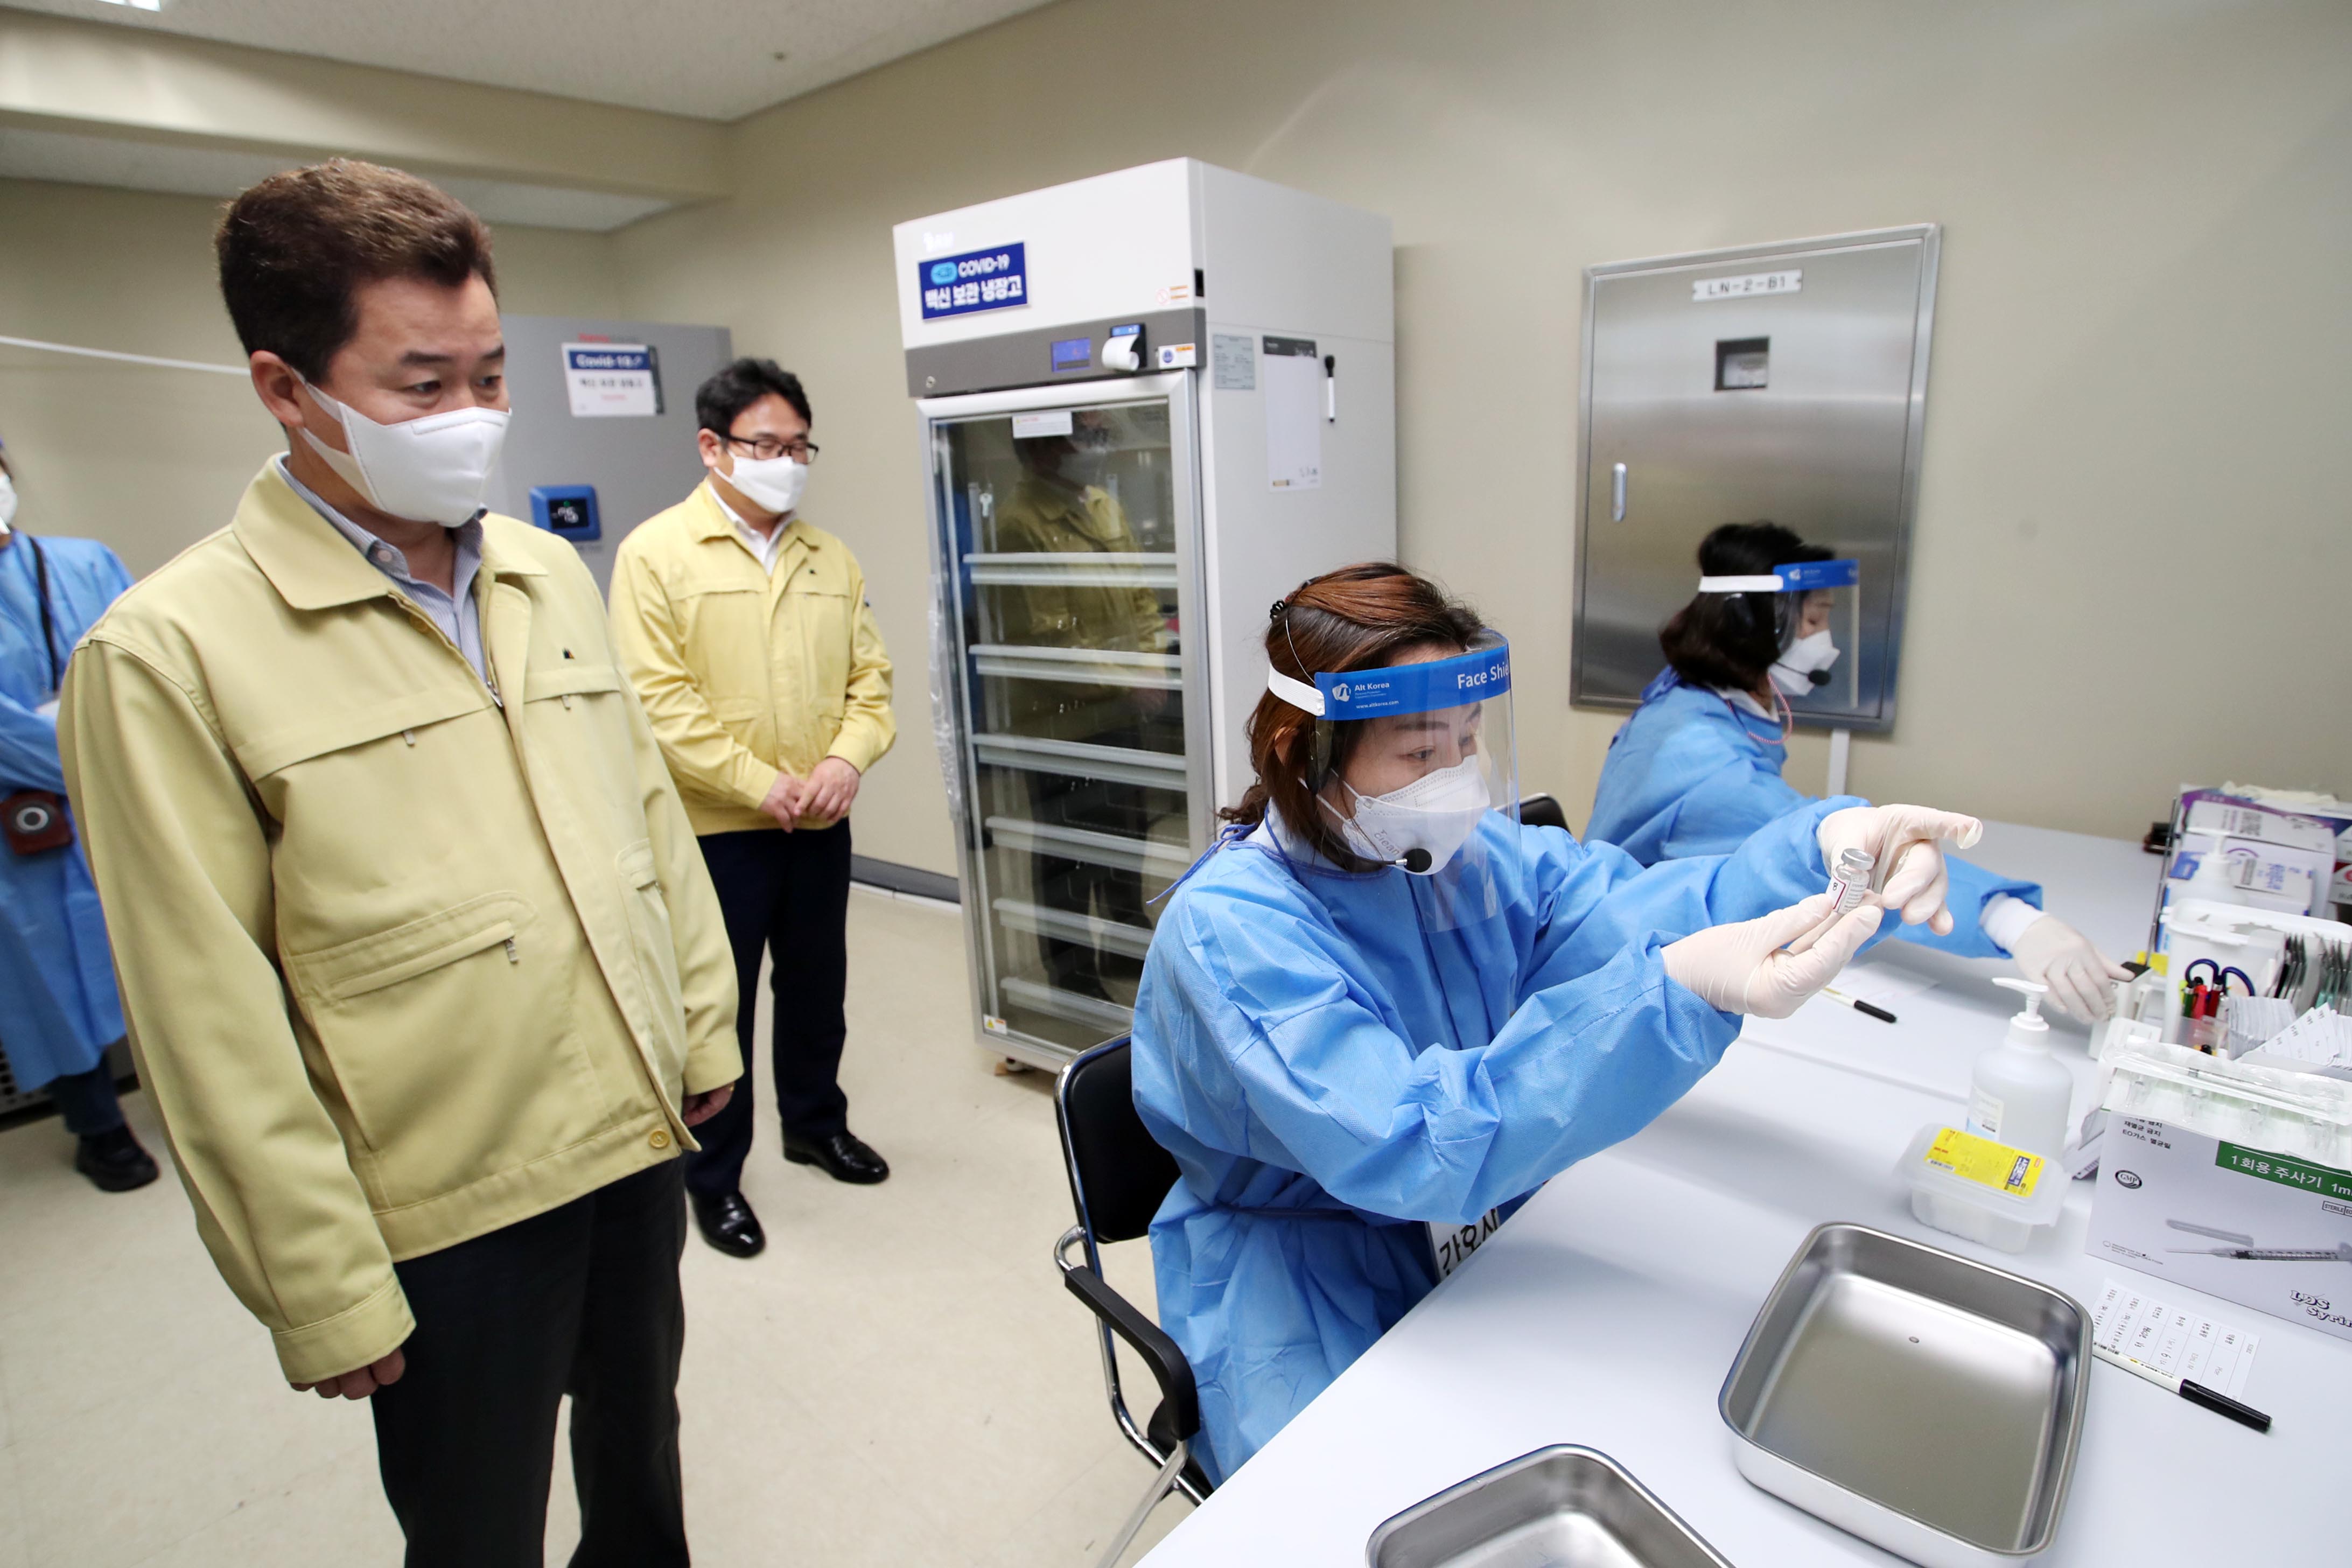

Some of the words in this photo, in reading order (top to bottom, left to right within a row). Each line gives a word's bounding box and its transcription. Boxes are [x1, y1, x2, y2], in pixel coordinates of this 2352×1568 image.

[958, 254, 1010, 278] COVID-19
[925, 286, 952, 310] 백신
[953, 282, 980, 306] 보관
[981, 275, 1023, 302] 냉장고
[1457, 671, 1488, 689] Face
[1356, 700, 1399, 709] www.altkorea.com
[2122, 1129, 2146, 1141] EO가스
[2124, 1121, 2145, 1131] 재멸균
[2147, 1128, 2161, 1137] 금지
[2120, 1173, 2138, 1184] GMP
[2274, 1166, 2322, 1188] 주사기
[2324, 1203, 2344, 1213] STERILE
[2290, 1290, 2330, 1310] LDS
